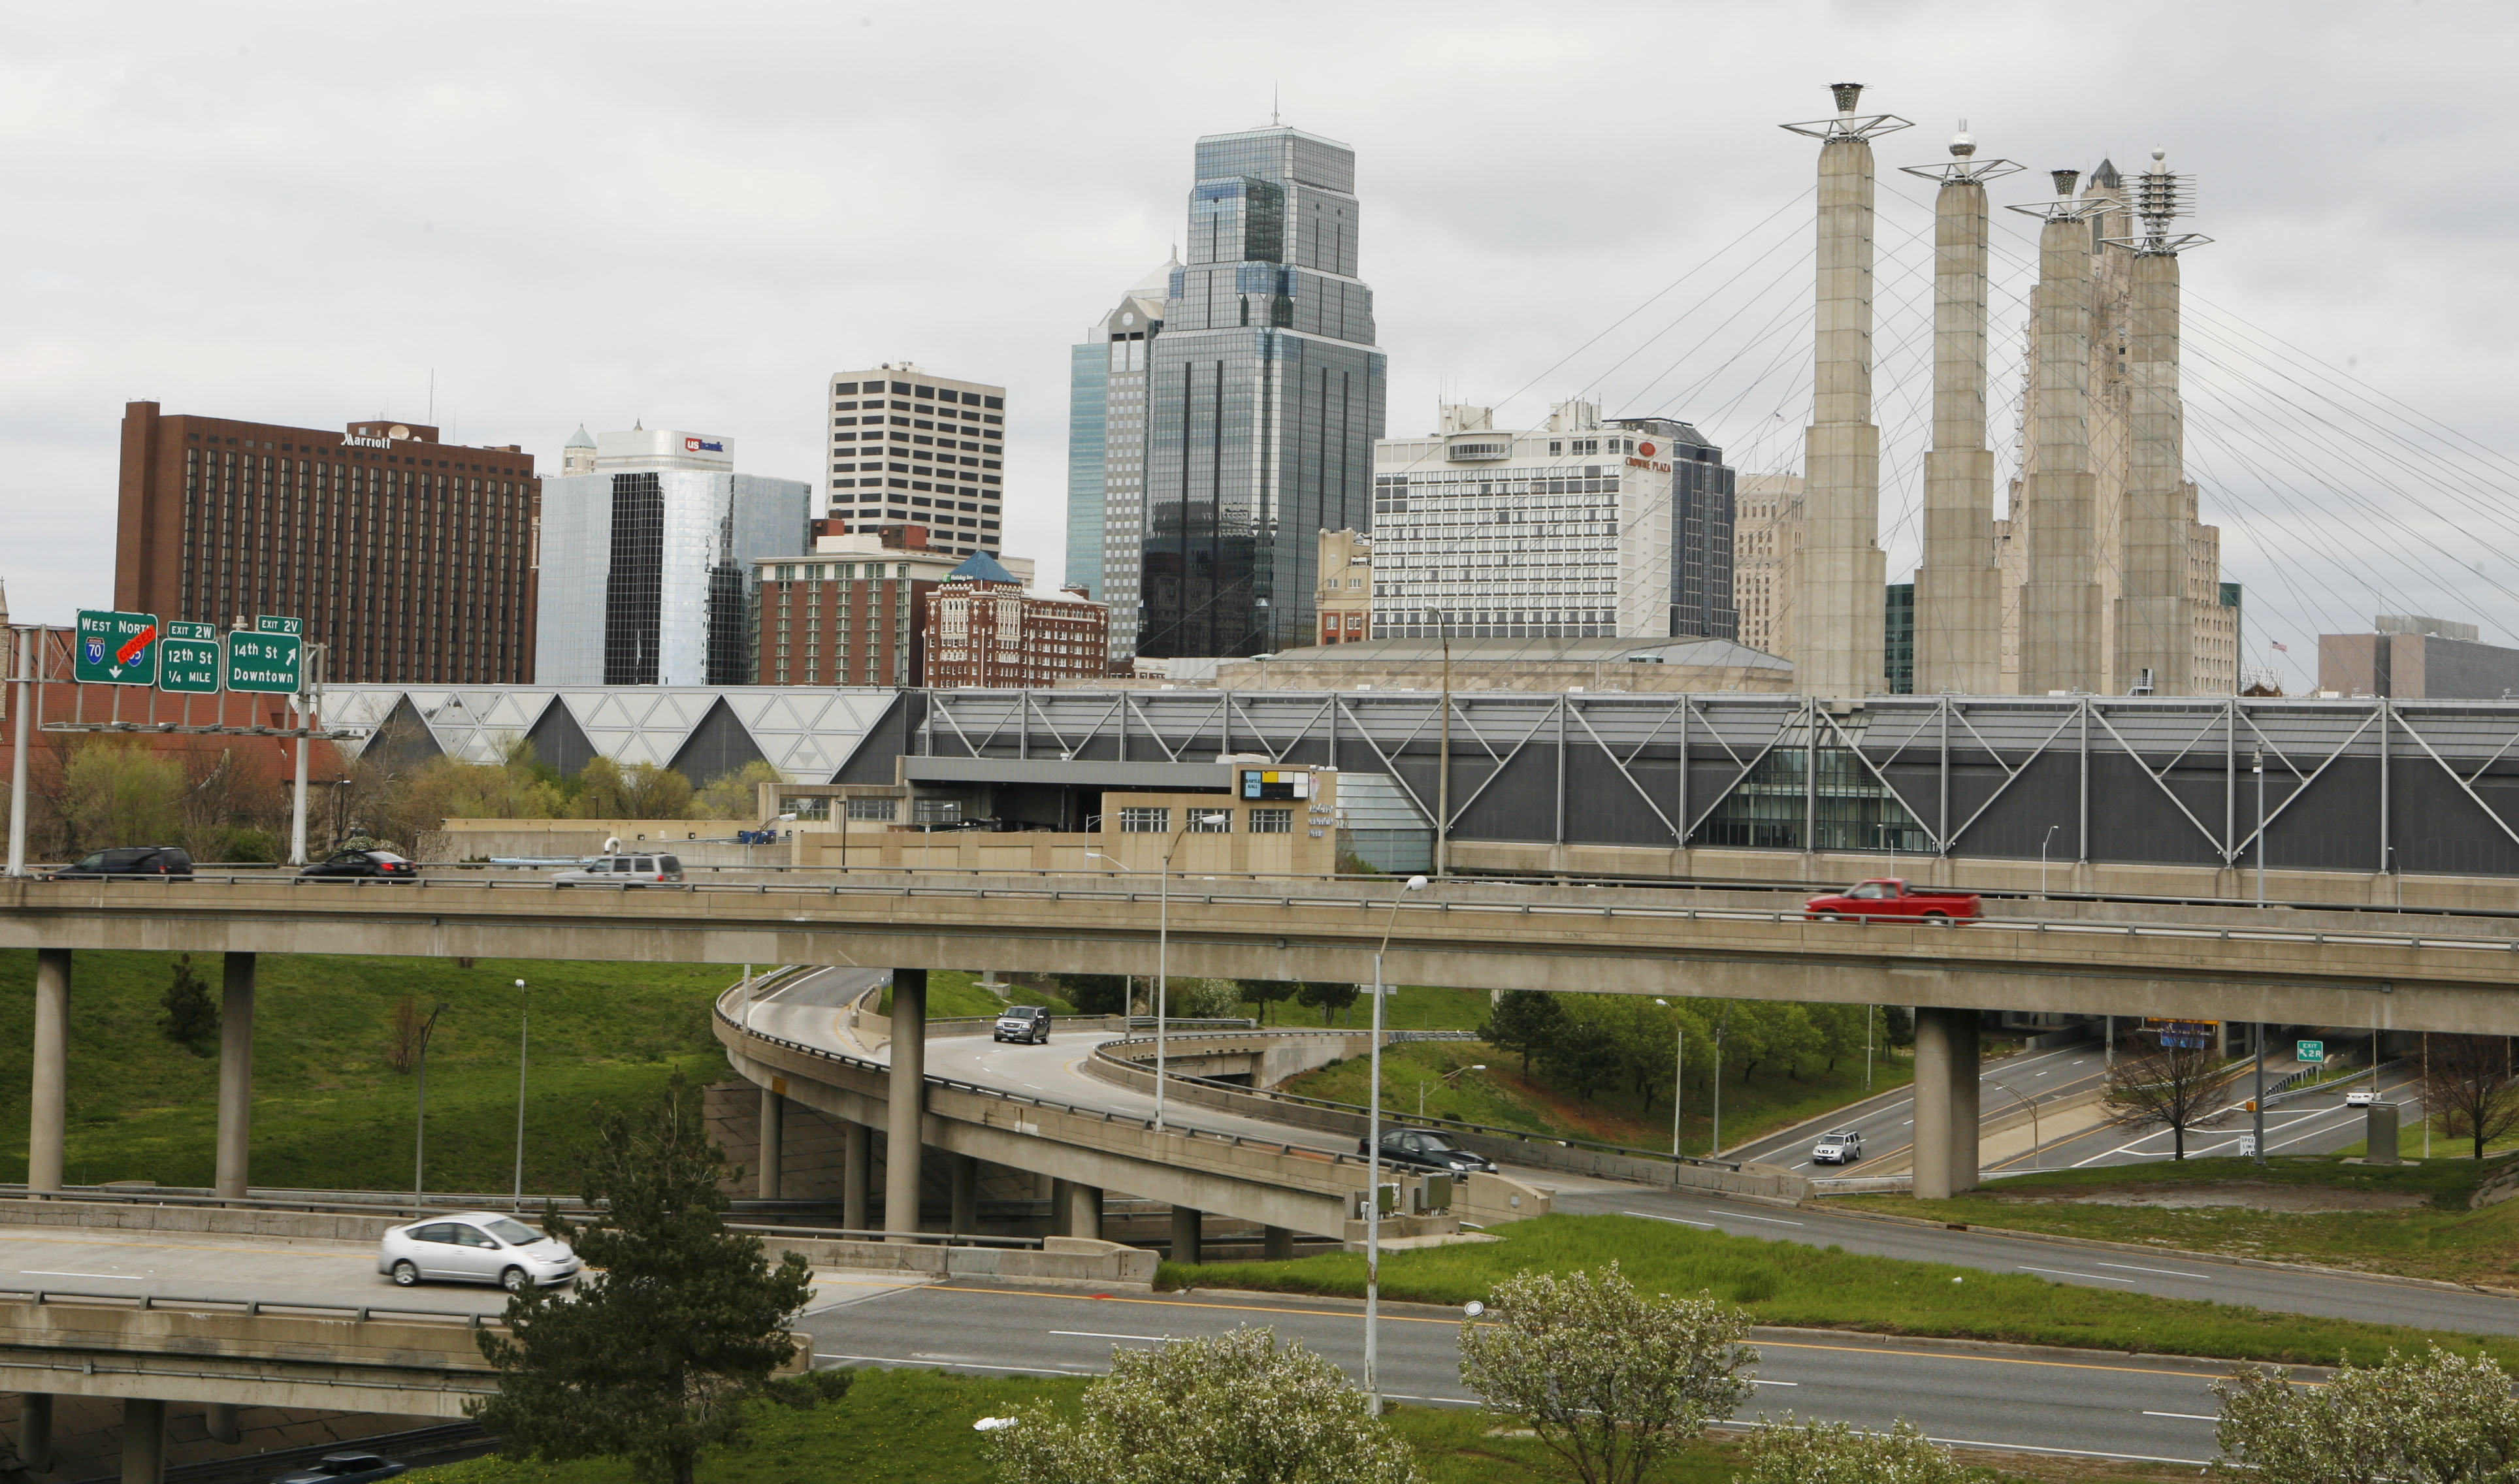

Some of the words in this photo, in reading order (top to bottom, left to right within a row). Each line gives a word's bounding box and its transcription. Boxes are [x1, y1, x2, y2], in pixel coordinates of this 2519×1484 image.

[340, 433, 391, 449] Marriott
[1653, 461, 1671, 473] PLAZA
[82, 618, 111, 632] WEST
[119, 621, 149, 634] NORT
[171, 626, 189, 635] EXIT
[195, 626, 212, 639] 2W
[262, 620, 278, 629] EXIT
[284, 621, 298, 632] 2V
[89, 644, 101, 657] 70
[120, 630, 153, 660] CLOSED
[235, 643, 259, 656] 14th
[265, 646, 278, 659] St
[169, 649, 193, 662] 12th
[199, 651, 212, 664] St
[189, 671, 210, 683] MILE
[234, 668, 293, 683] Downtown
